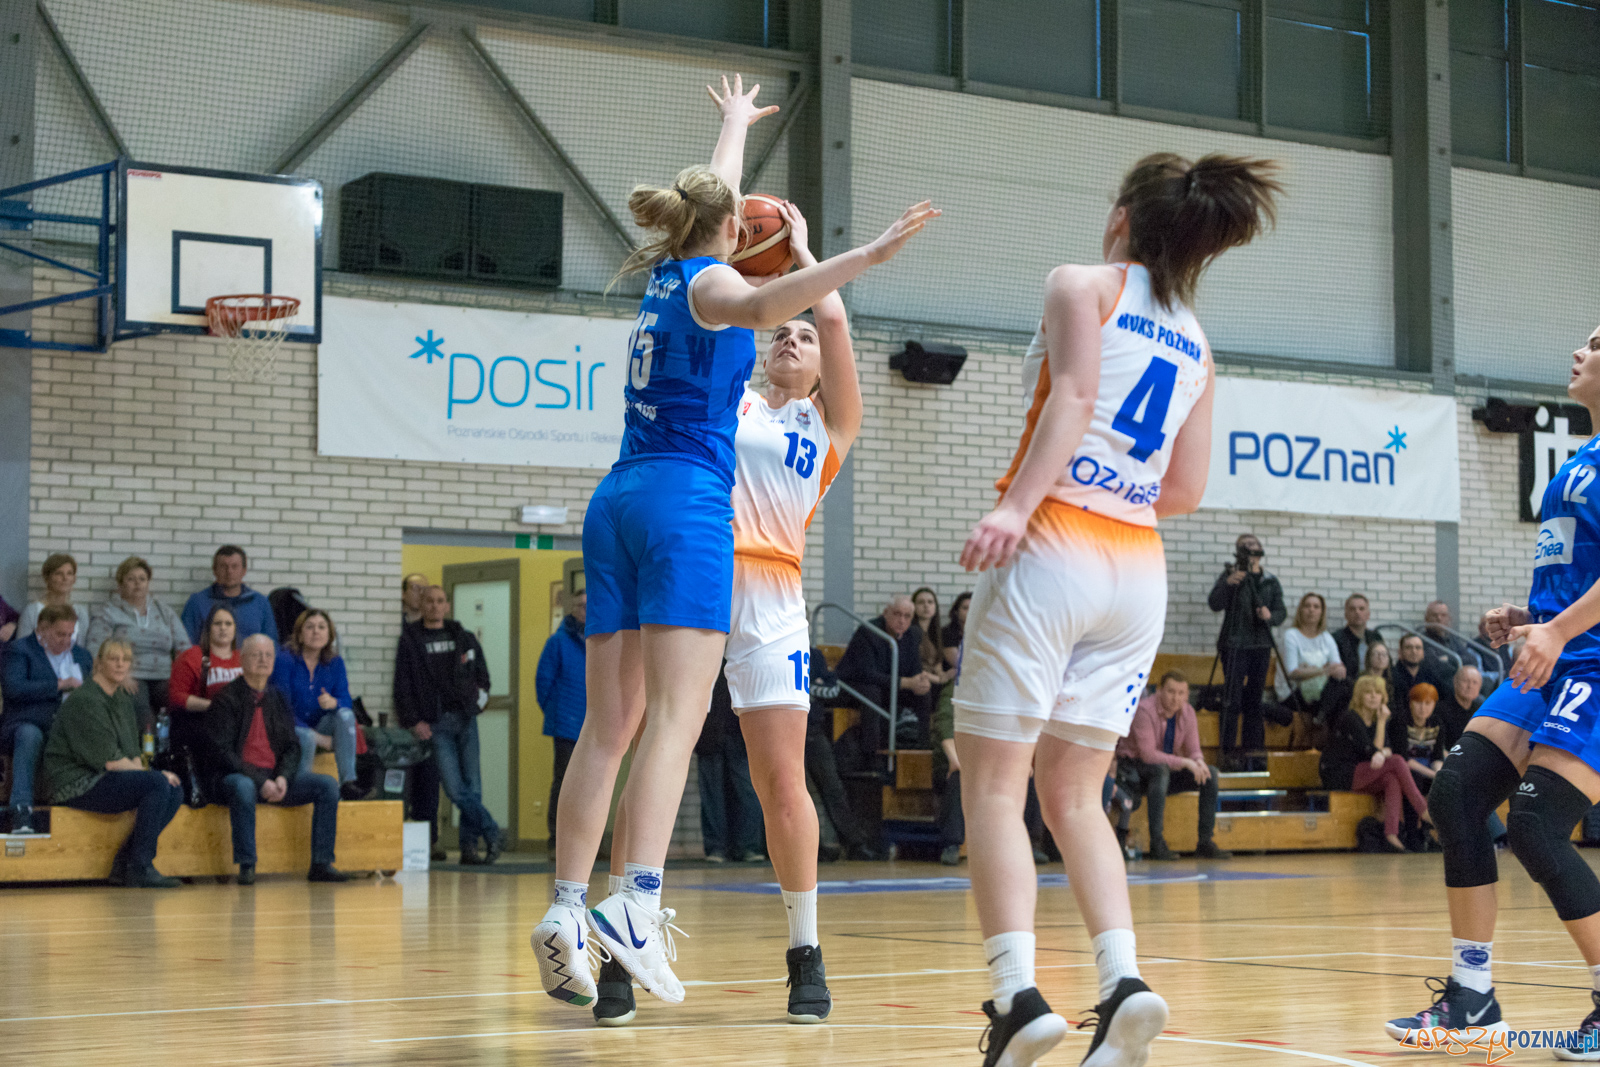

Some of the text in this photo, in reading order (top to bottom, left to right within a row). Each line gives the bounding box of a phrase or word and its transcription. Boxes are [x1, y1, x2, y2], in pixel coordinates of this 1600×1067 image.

[626, 310, 659, 390] 15
[447, 344, 606, 420] posir
[1112, 355, 1179, 463] 4
[784, 431, 818, 479] 13
[1562, 463, 1597, 504] 12
[1550, 678, 1592, 722] 12
